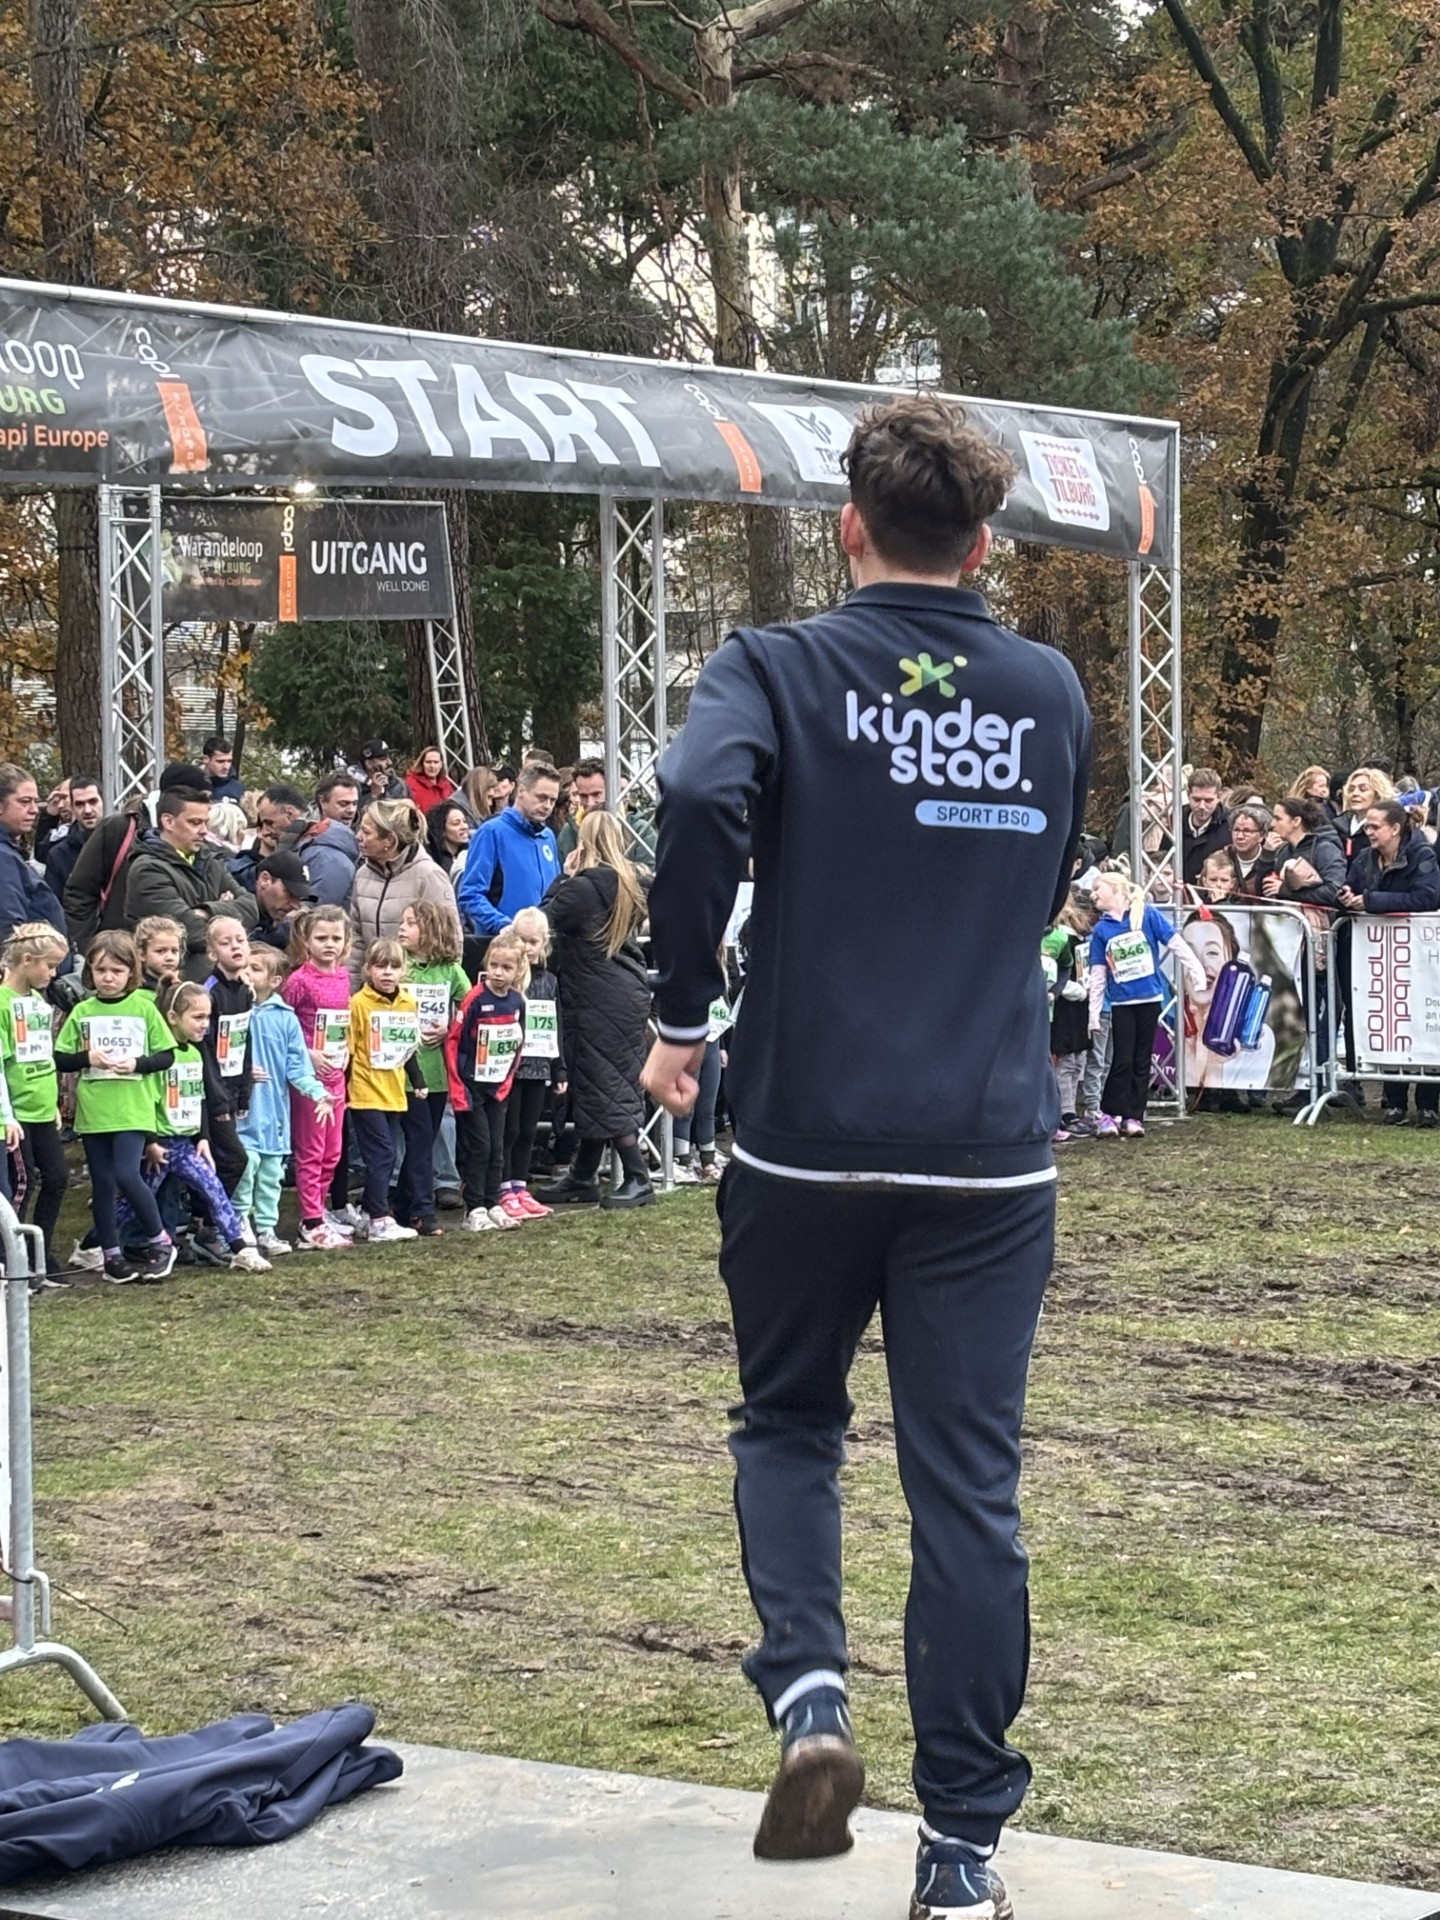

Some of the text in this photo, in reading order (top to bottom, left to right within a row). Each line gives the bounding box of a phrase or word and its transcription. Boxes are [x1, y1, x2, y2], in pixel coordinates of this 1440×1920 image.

[300, 354, 661, 468] START
[34, 424, 109, 452] Europe
[1050, 478, 1097, 507] TILBURG
[177, 536, 263, 563] Warandeloop
[311, 541, 428, 575] UITGANG
[376, 580, 430, 592] WELL DONE!
[846, 690, 1036, 751] kinder
[936, 805, 993, 824] SPORT
[1119, 943, 1145, 960] 346
[532, 1016, 555, 1030] 175
[97, 1037, 132, 1047] 10653
[388, 1028, 416, 1042] 544
[497, 1040, 519, 1055] 830
